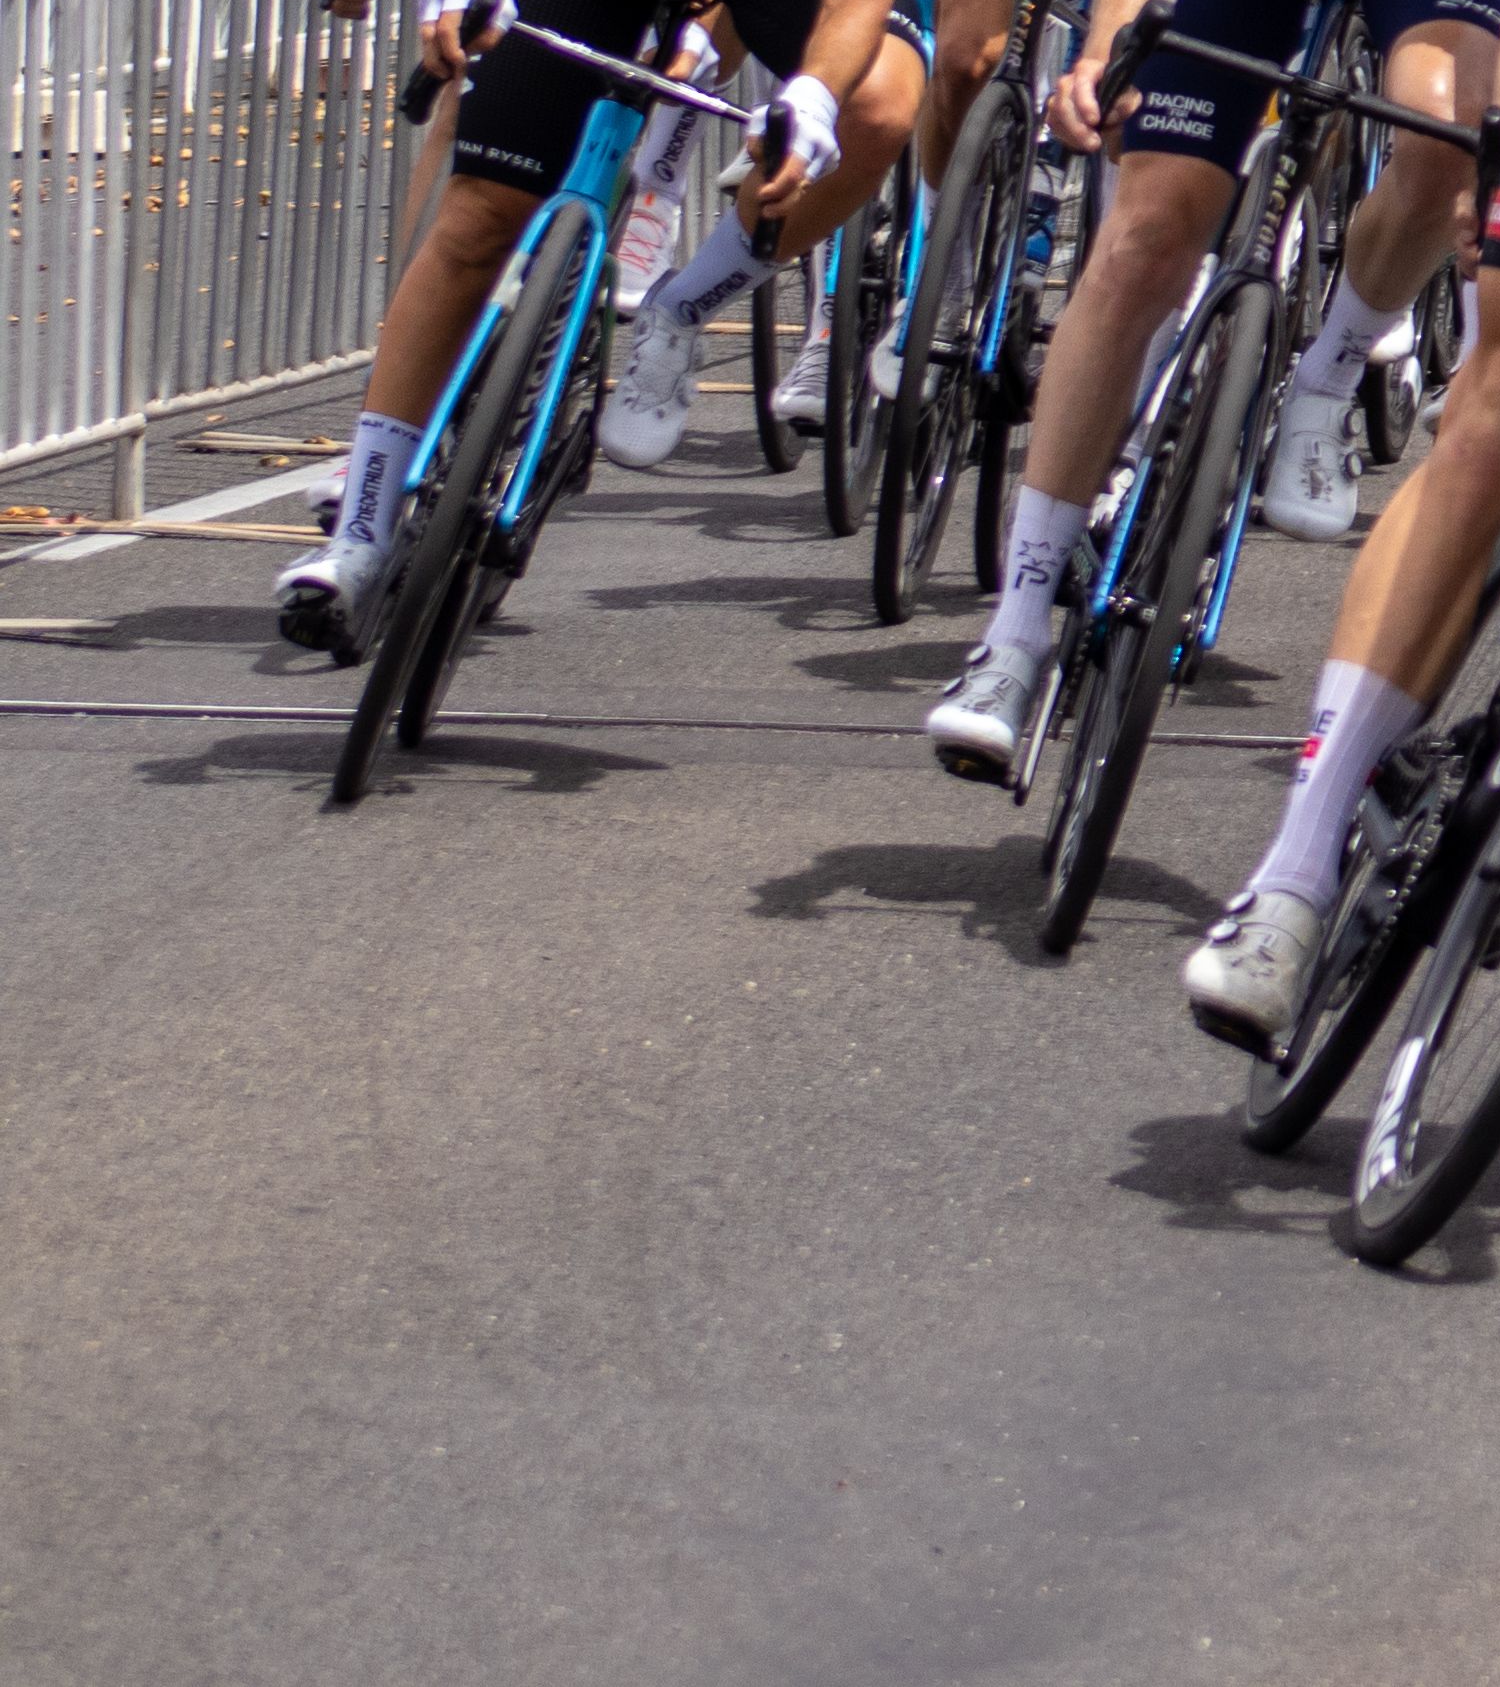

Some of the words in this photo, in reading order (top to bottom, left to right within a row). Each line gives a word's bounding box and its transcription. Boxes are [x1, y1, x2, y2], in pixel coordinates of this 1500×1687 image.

[1149, 92, 1215, 114] RACING
[1142, 117, 1214, 139] CHANGE
[487, 147, 543, 174] RYSEL
[1253, 155, 1295, 262] FACTOR
[366, 451, 386, 528] DECATHLON
